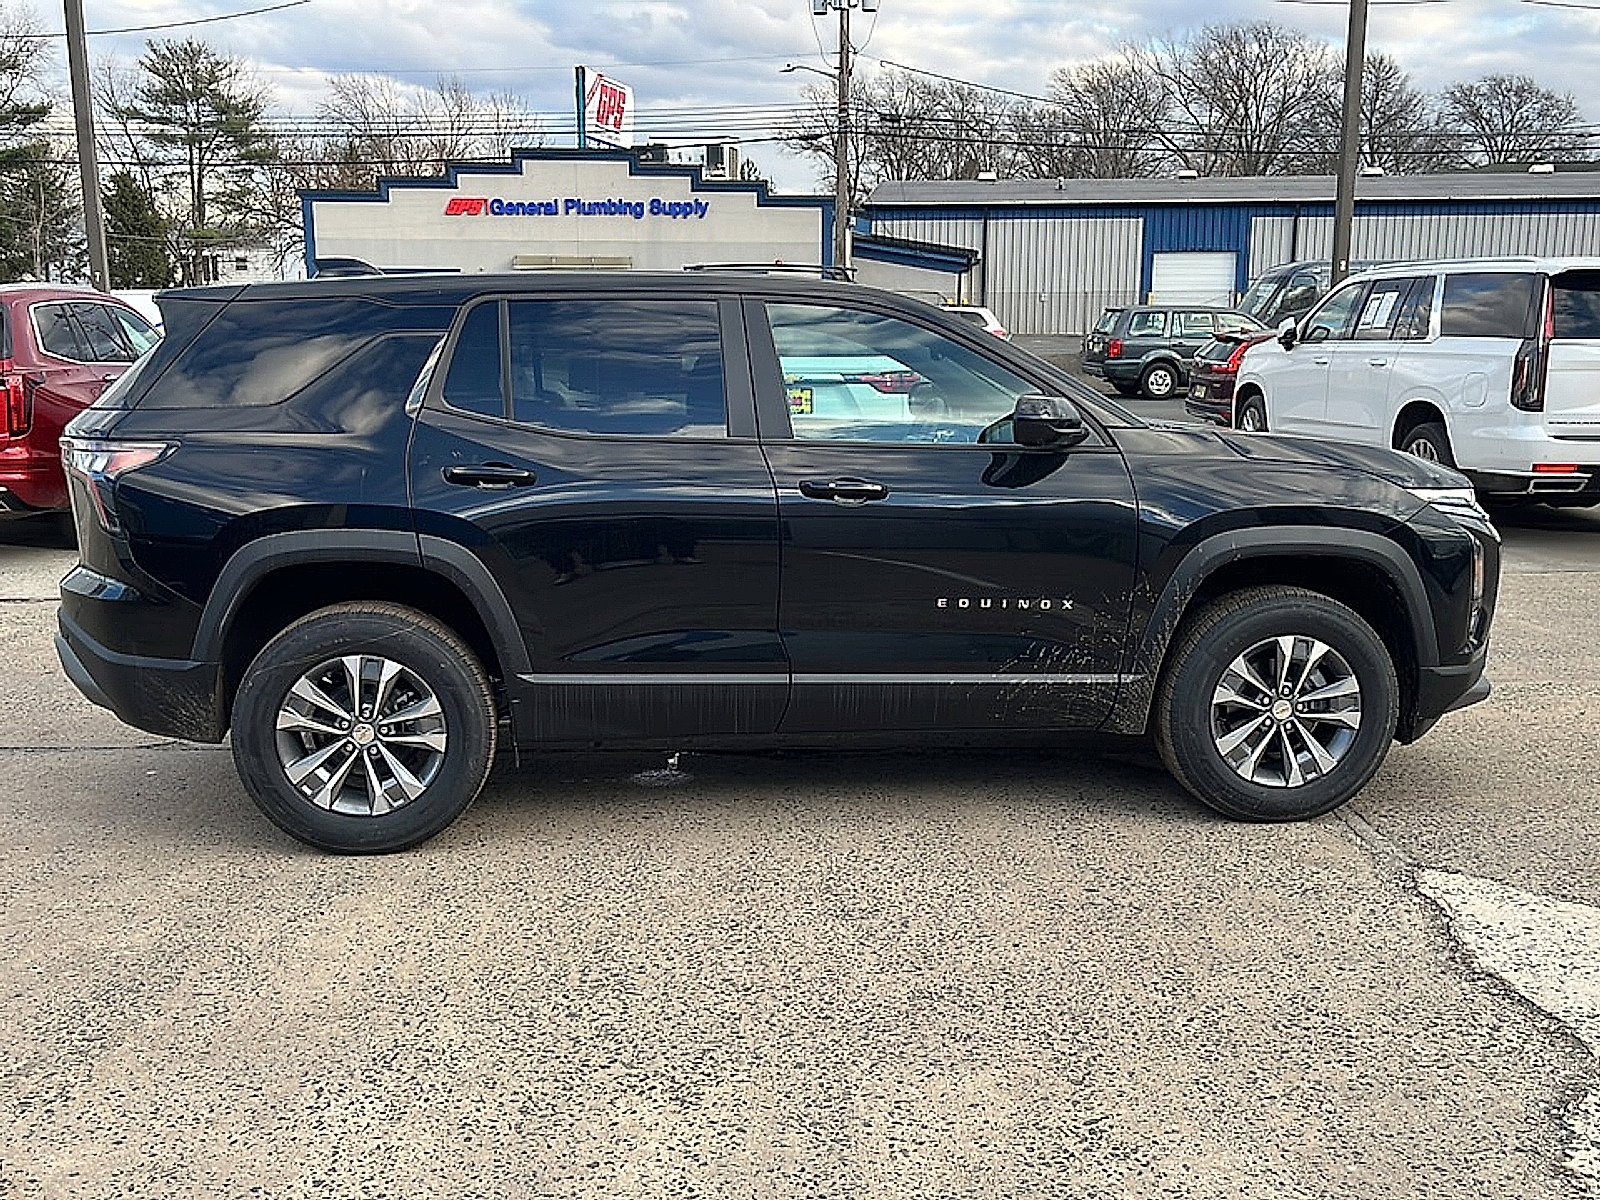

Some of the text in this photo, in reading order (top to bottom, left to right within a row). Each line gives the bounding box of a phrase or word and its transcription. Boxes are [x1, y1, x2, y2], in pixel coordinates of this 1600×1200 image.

[490, 198, 559, 216] General
[564, 198, 645, 219] Plumbing
[649, 198, 709, 219] Supply
[936, 598, 1075, 611] EQUINOX
